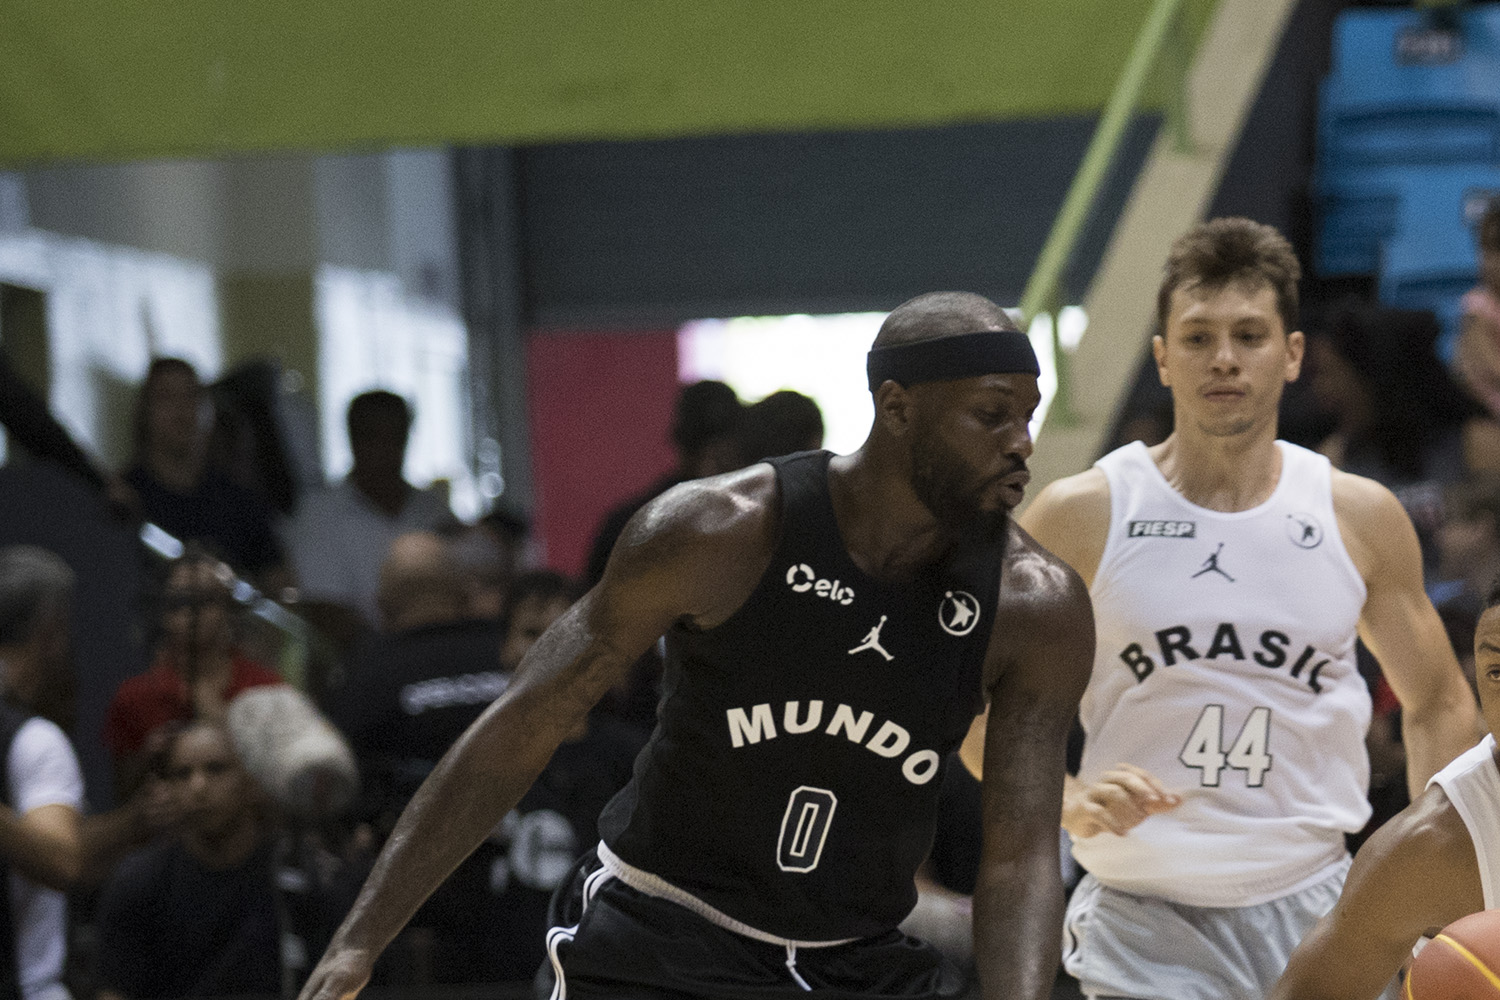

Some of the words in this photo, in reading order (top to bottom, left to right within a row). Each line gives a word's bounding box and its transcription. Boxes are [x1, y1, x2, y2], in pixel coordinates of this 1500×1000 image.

[1131, 521, 1193, 537] FIESP
[726, 699, 940, 786] MUNDO
[1180, 704, 1273, 788] 44
[776, 785, 838, 873] 0
